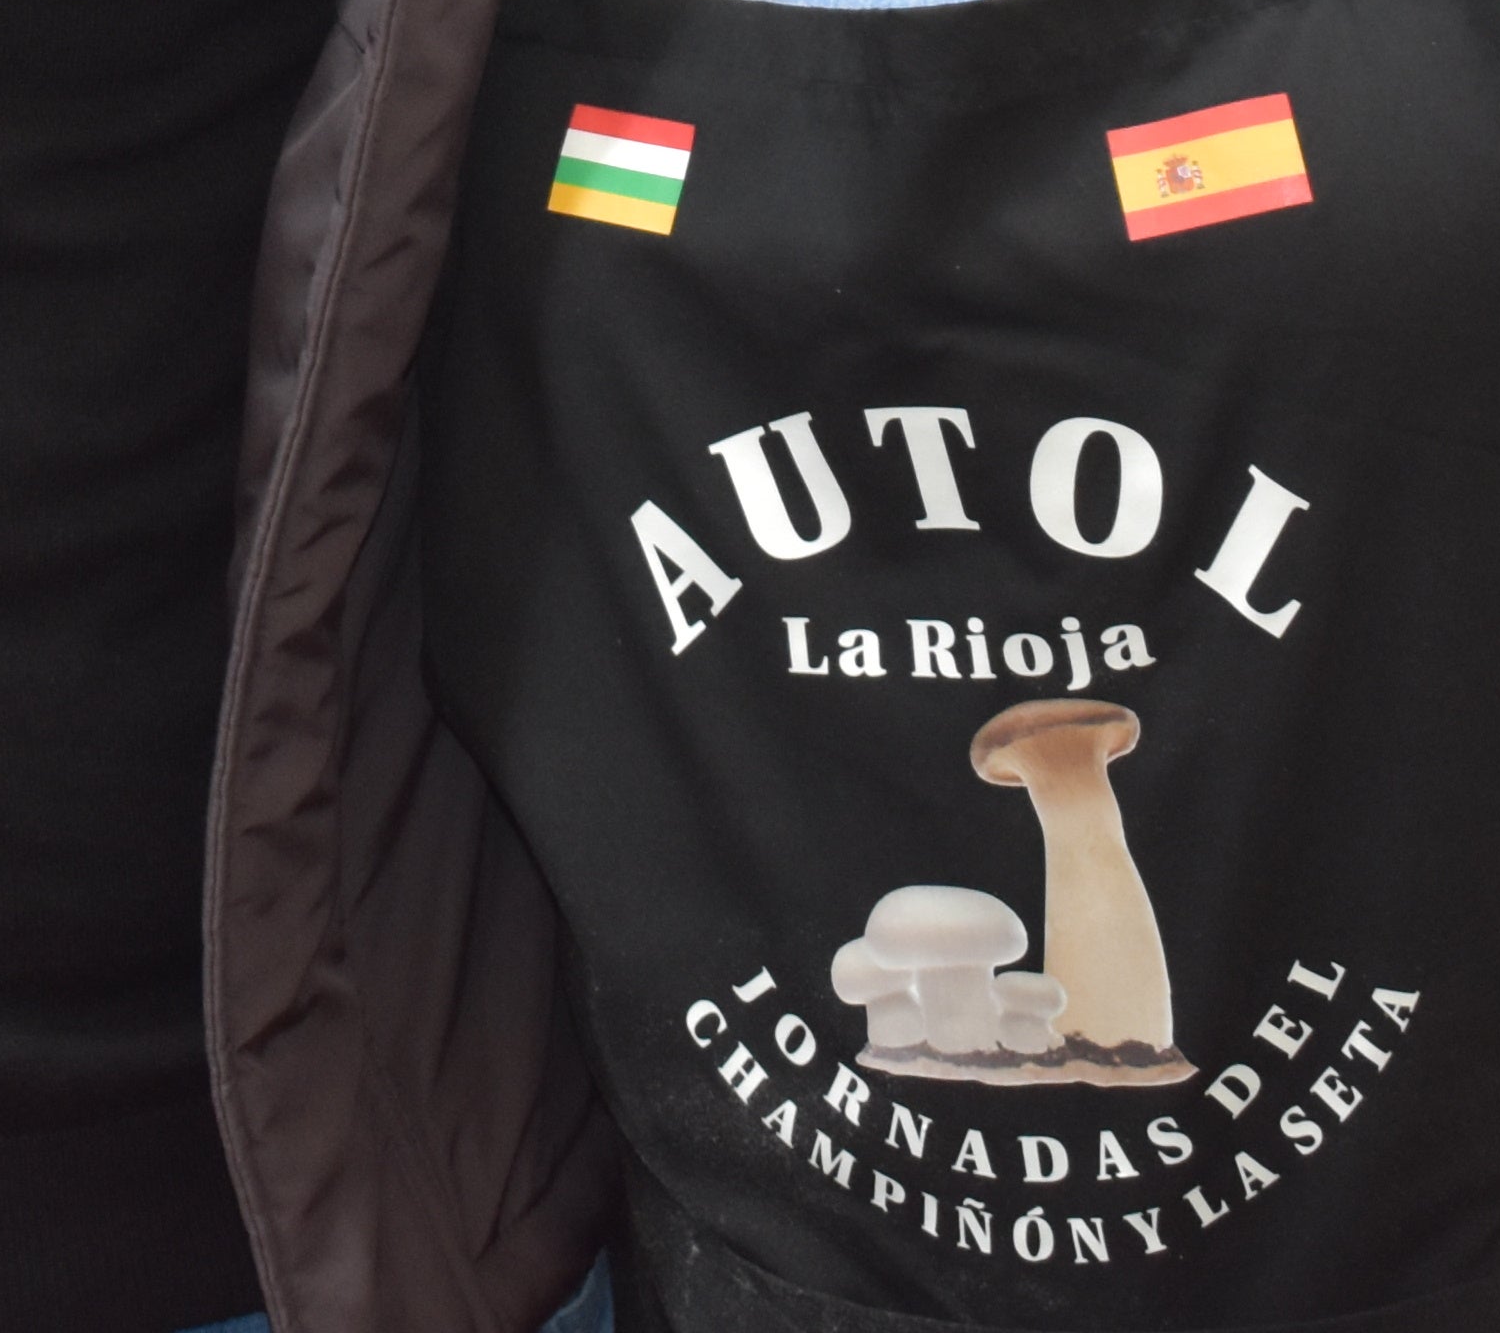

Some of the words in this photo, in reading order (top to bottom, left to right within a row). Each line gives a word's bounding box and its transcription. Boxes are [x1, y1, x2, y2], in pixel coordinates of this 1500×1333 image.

[630, 406, 1311, 655] AUTOL
[782, 616, 886, 677] La
[907, 617, 1156, 690] Rioja
[685, 999, 1110, 1264] CHAMPIÑÓN
[1122, 1207, 1168, 1254] Y
[1183, 1150, 1281, 1228] LA
[1279, 987, 1421, 1156] SETA
[732, 965, 1194, 1185] JORNADAS
[1204, 959, 1347, 1121] DEL
